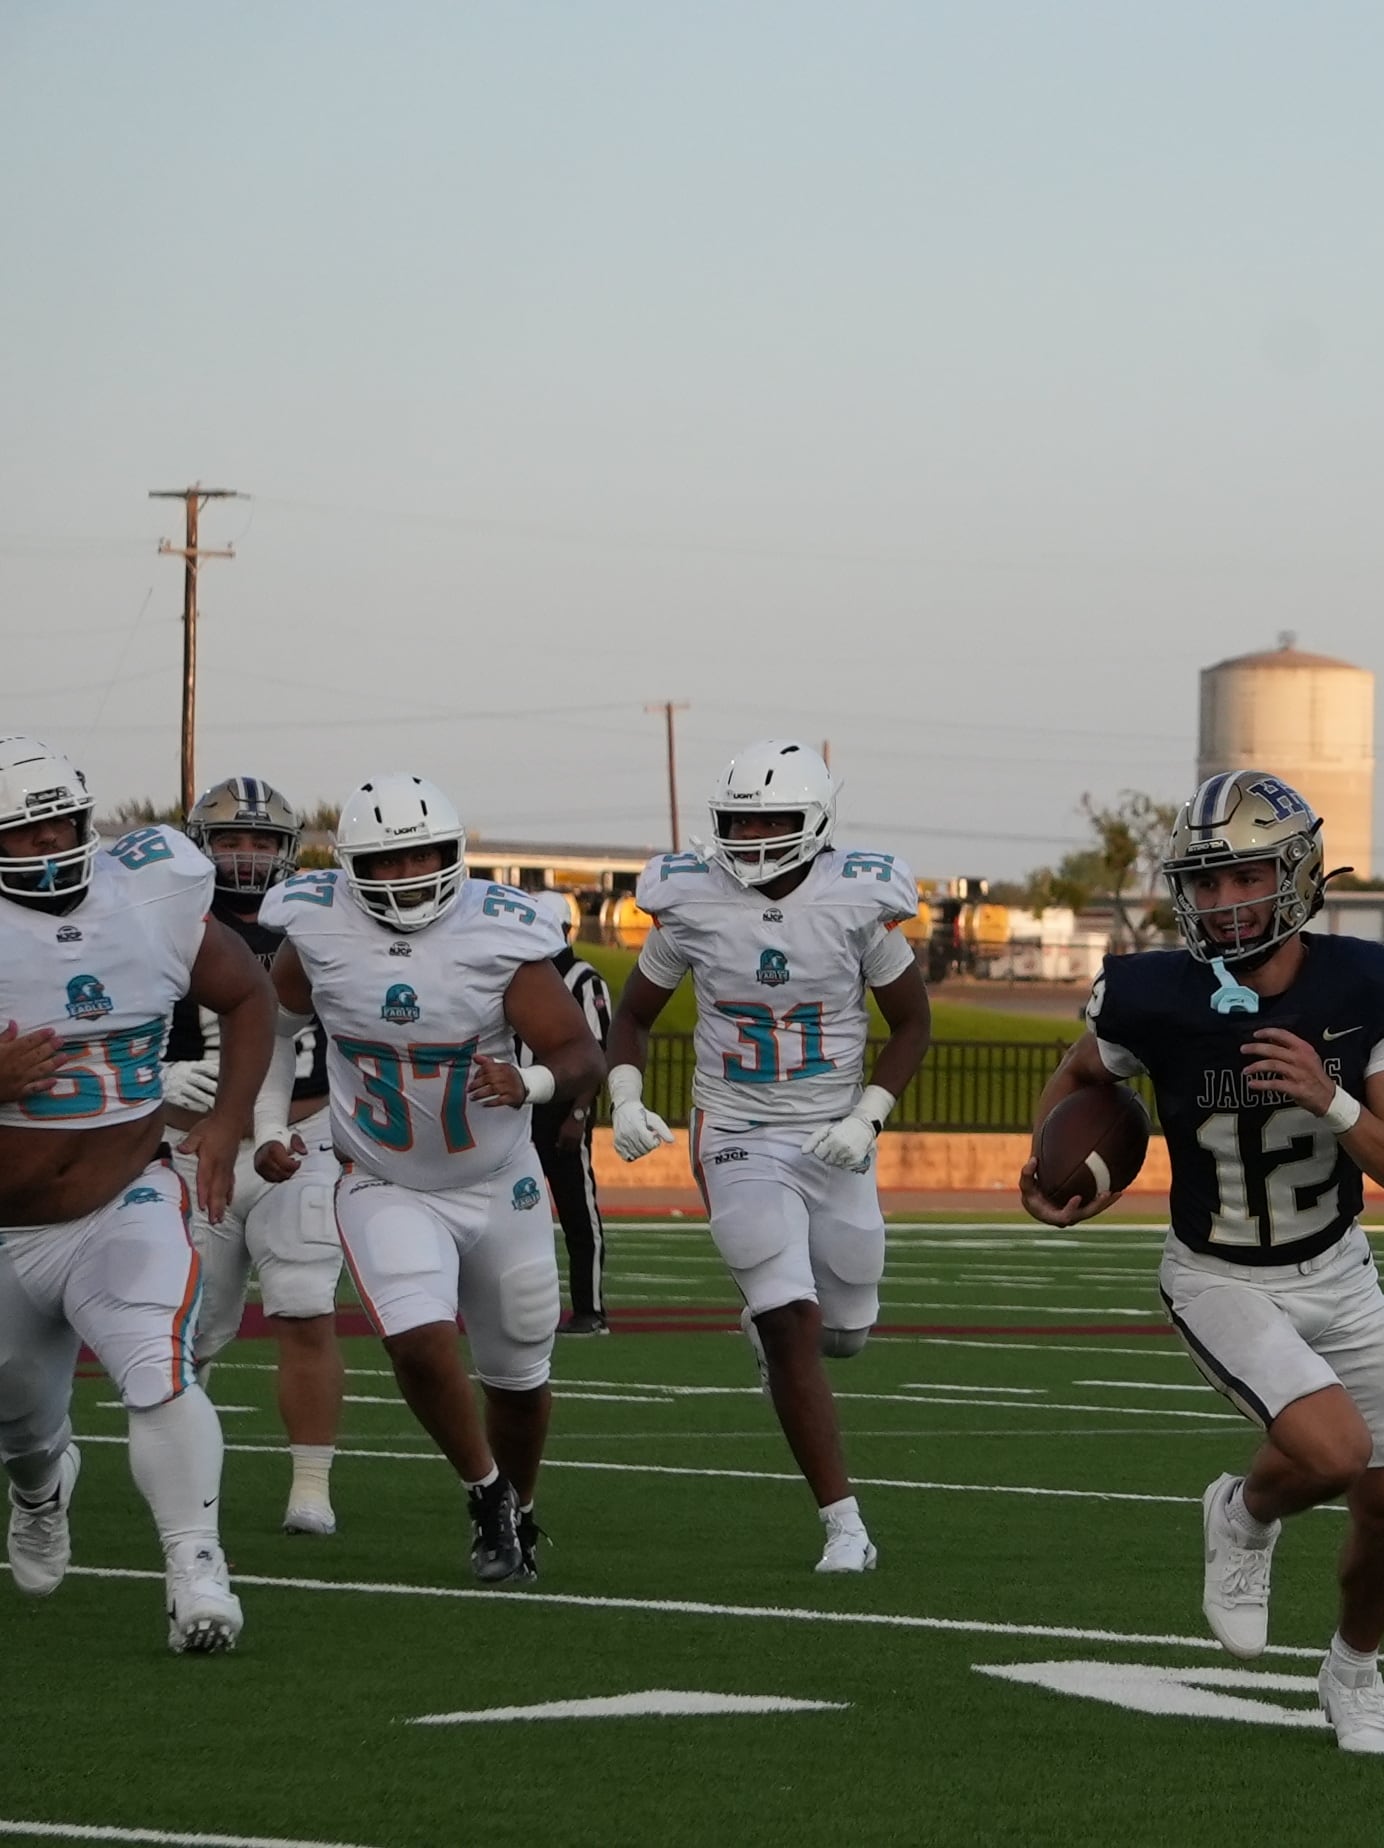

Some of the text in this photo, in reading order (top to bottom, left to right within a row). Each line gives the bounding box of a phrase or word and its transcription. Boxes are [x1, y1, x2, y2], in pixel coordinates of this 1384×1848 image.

[283, 871, 338, 907] 37
[842, 852, 895, 882] 31
[714, 1001, 838, 1083] 31
[331, 1034, 479, 1154] 37
[1197, 1058, 1343, 1108] JACKS
[1196, 1107, 1341, 1247] 12
